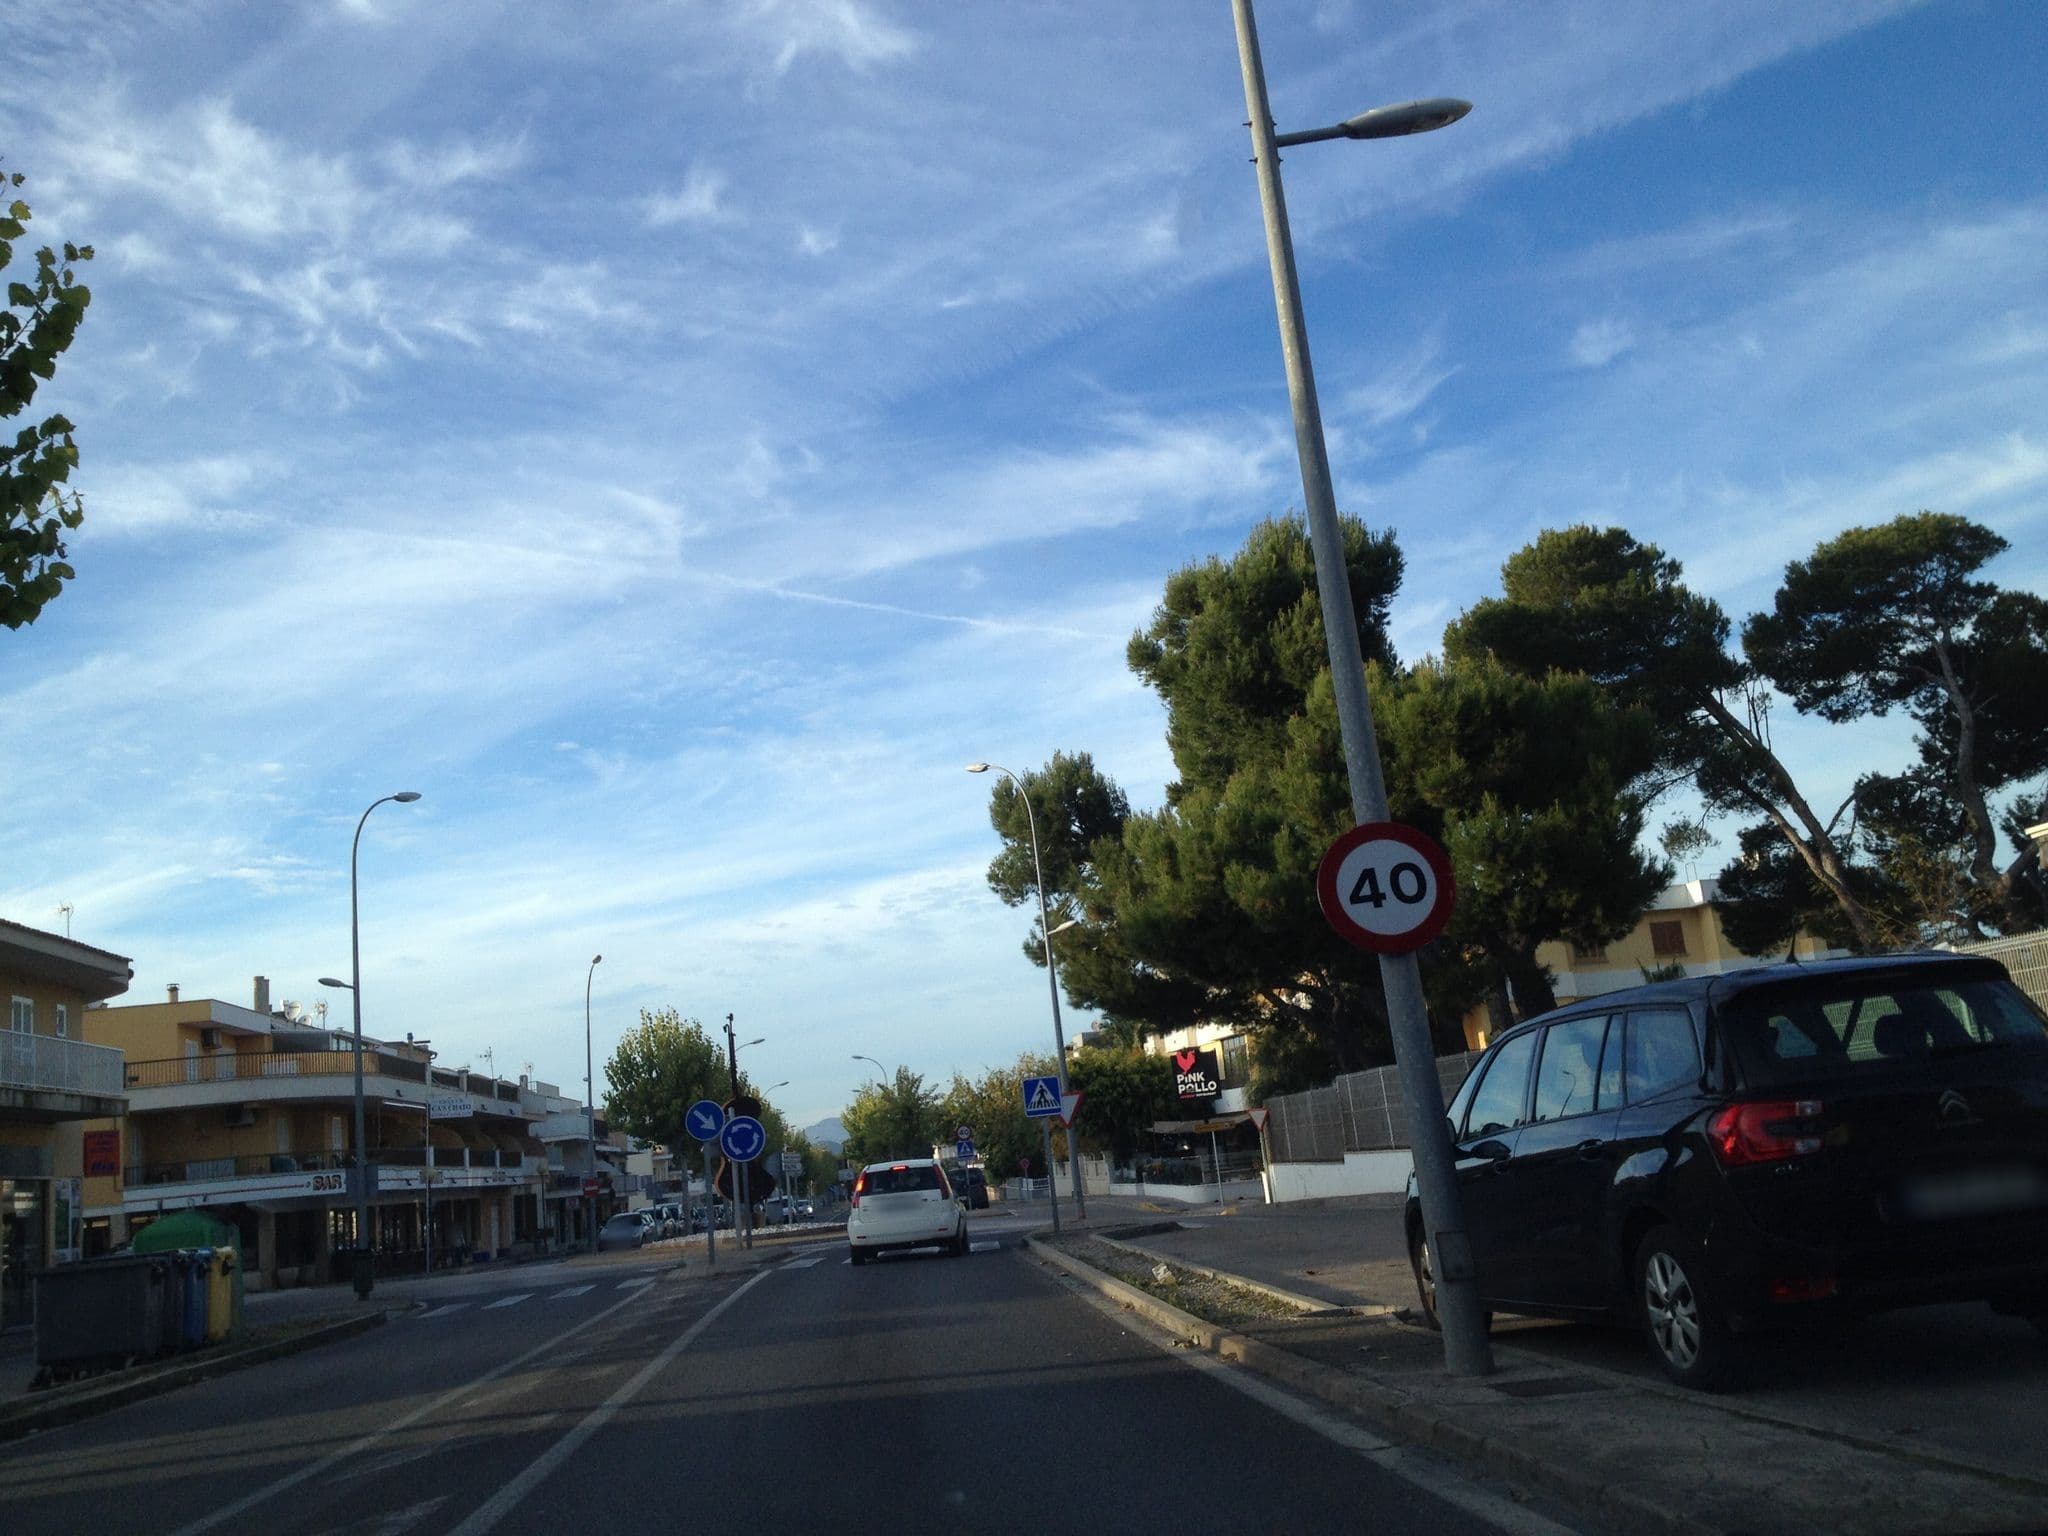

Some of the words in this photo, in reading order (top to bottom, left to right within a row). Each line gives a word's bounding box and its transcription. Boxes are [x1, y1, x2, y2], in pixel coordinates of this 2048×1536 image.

[1349, 862, 1427, 908] 40
[1178, 1080, 1217, 1094] POLLO
[313, 1174, 342, 1190] BAR
